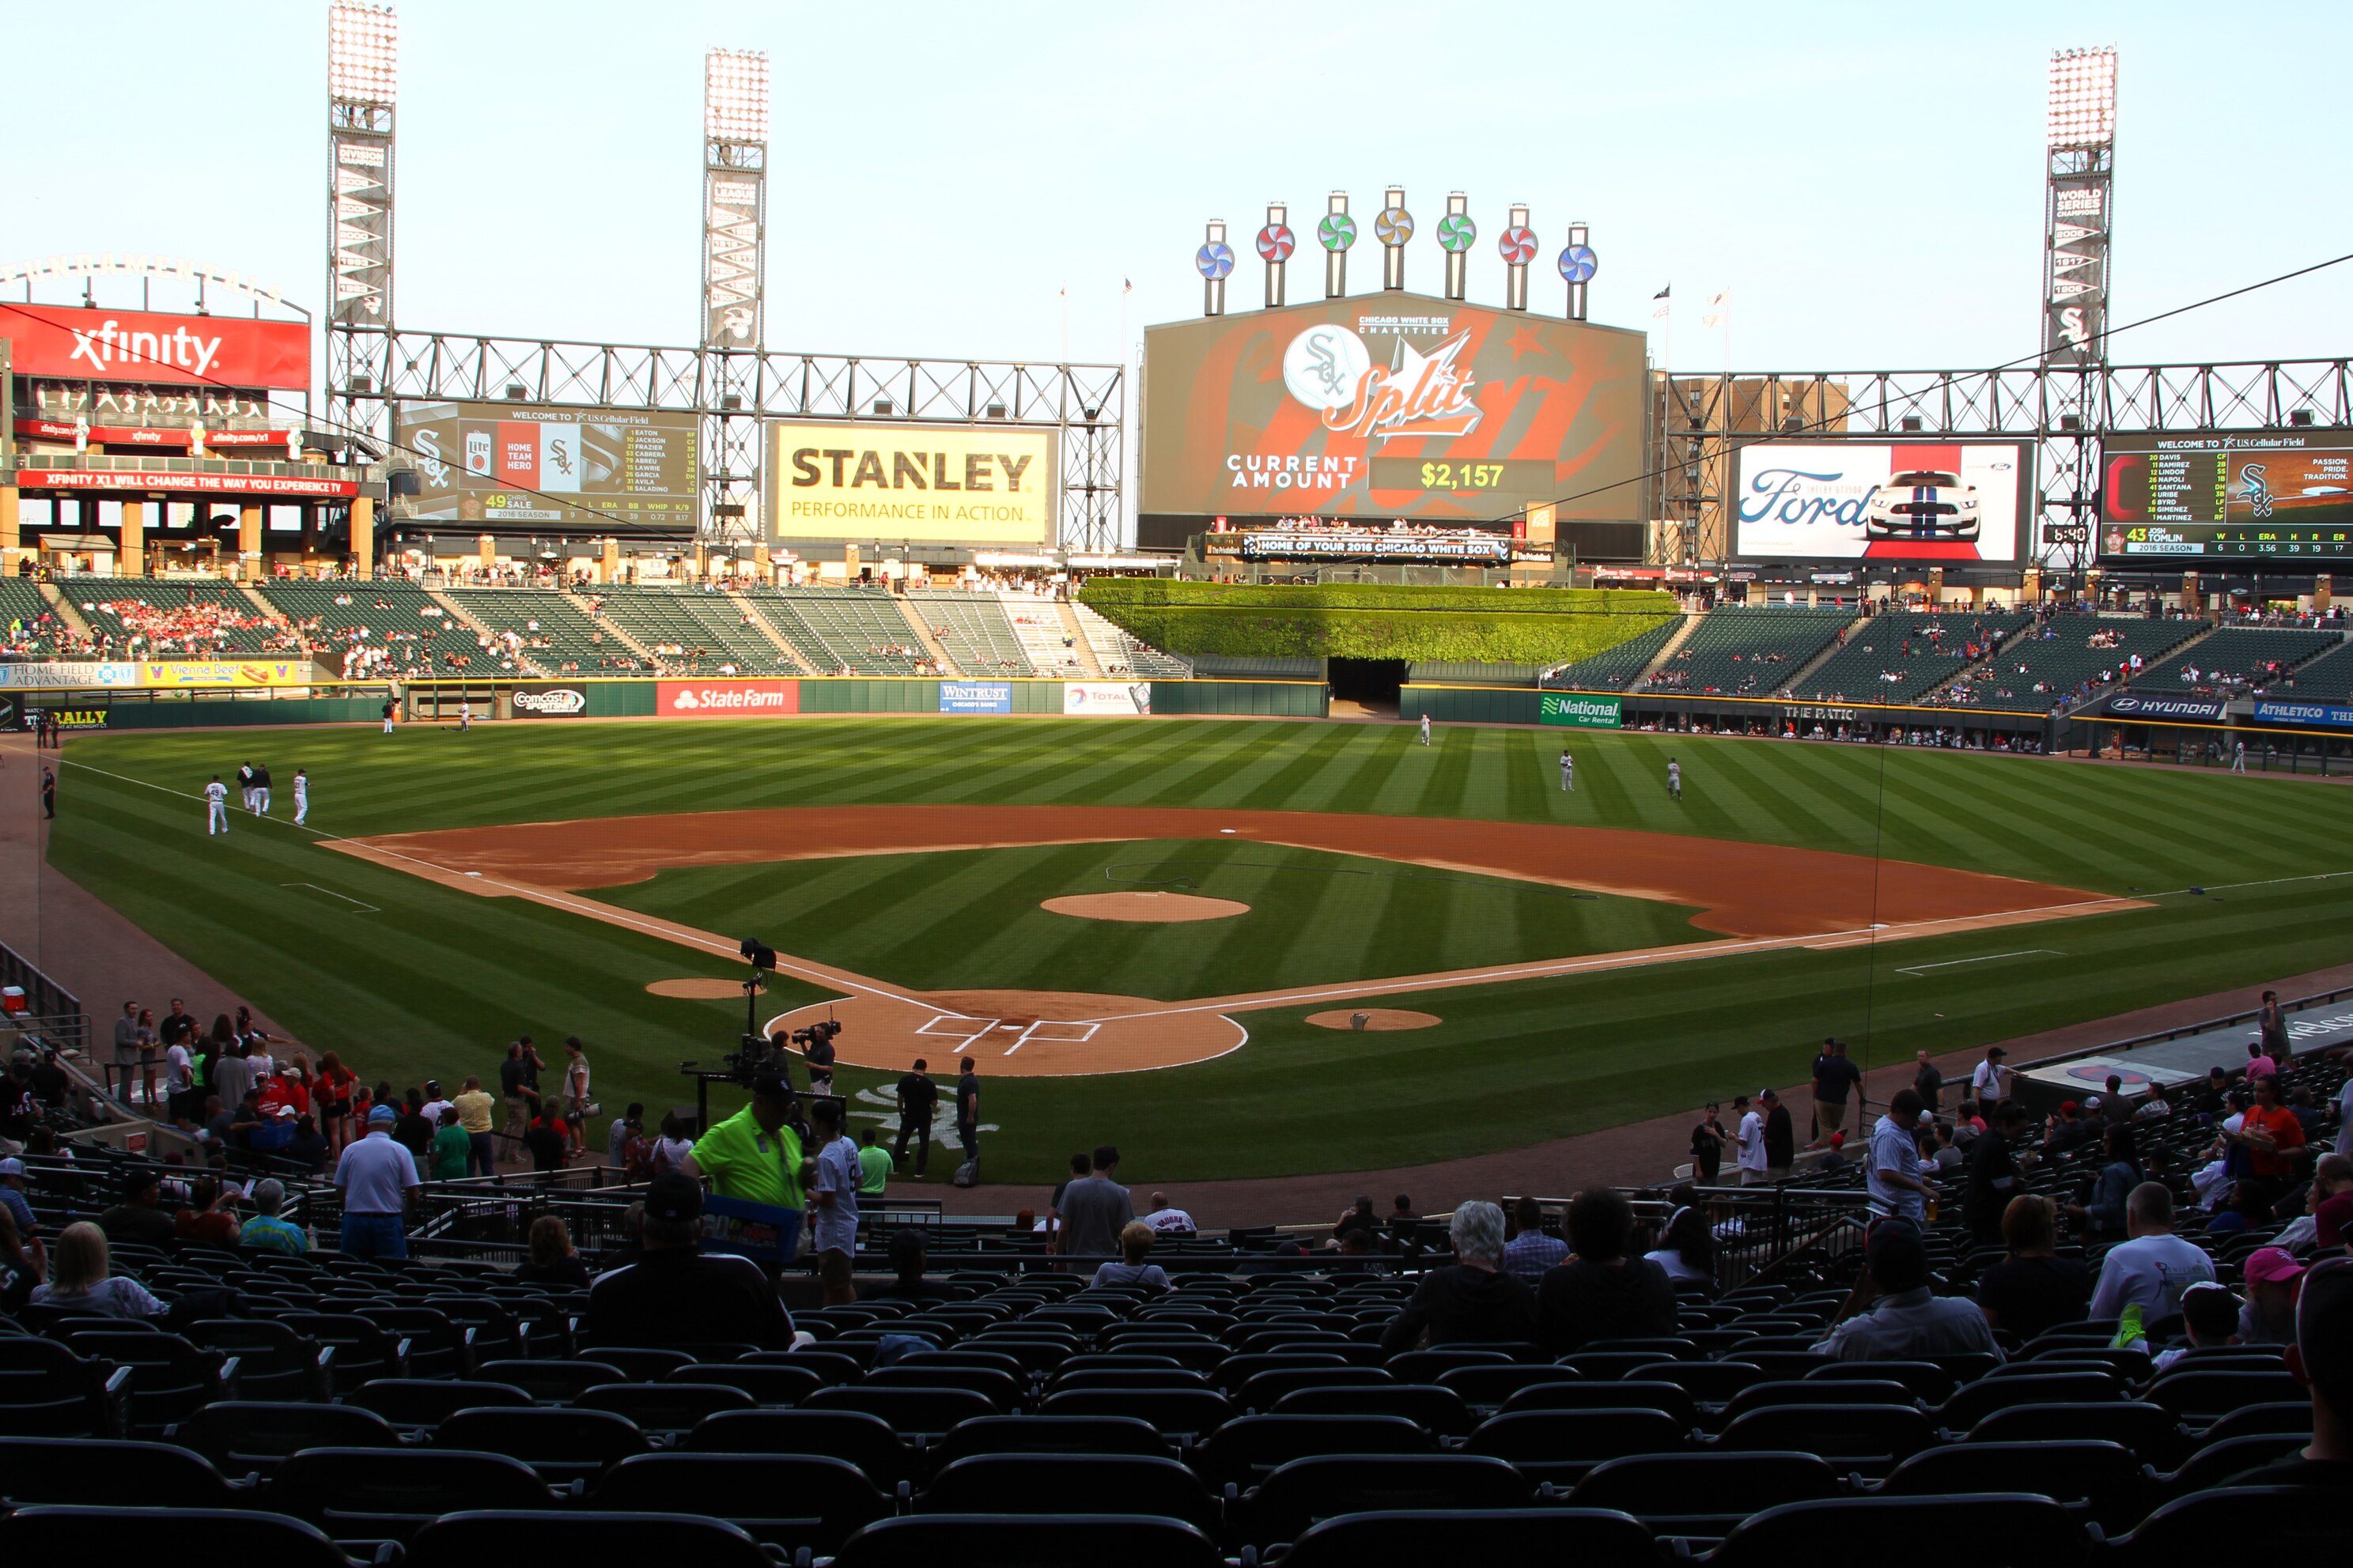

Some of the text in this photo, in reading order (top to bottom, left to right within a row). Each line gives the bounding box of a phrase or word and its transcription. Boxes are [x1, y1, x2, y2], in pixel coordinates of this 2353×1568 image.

[339, 149, 384, 161] DIVISION
[339, 157, 384, 167] CHAMPIONS
[714, 182, 756, 191] AMERICAN
[714, 189, 756, 199] LEAGUE
[2056, 189, 2101, 201] WORLD
[714, 197, 756, 206] CHAMPIONS
[2056, 199, 2101, 211] SERIES
[2056, 209, 2101, 217] CHAMPIONS
[70, 320, 222, 376] xfinity
[1321, 360, 1476, 438] Split
[513, 411, 558, 421] WELCOME
[600, 415, 629, 425] Cellular
[213, 433, 268, 444] xfinity.com/x1
[2158, 440, 2204, 449] WELCOME
[2250, 437, 2304, 448] Cellular Field
[468, 441, 489, 454] Lite
[1227, 455, 1357, 471] CURRENT
[792, 448, 1034, 493] STANLEY
[1421, 463, 1504, 489] $2,157
[47, 474, 341, 493] XFINITY X1 WILL CHANGE THE WAY YOU EXPERIENCE TV
[1232, 472, 1351, 489] AMOUNT
[1806, 485, 1832, 493] SHELBY
[486, 495, 506, 508] 49
[1738, 469, 1880, 526] Ford
[507, 501, 532, 509] SALE
[792, 501, 1023, 522] PERFORMANCE IN ACTION
[2054, 527, 2086, 541] 6:40
[2127, 528, 2146, 541] 43
[1262, 542, 1490, 555] HOME OF YOUR 2016 CHICAGO WHITE SOX
[14, 665, 94, 674] HOME FIELD
[170, 663, 240, 674] Vienna Beef
[14, 675, 94, 686] ADVANTAGE
[943, 686, 1008, 697] WINTRUST
[1092, 692, 1128, 701] TOTAL
[514, 691, 563, 707] Comcast
[1559, 700, 1618, 716] National
[1784, 707, 1856, 721] THE PATIO
[2141, 701, 2217, 715] HYUNDAI
[2259, 703, 2323, 718] ATHLETICO
[2331, 711, 2353, 722] THE
[1157, 1215, 1183, 1227] VAUGHN
